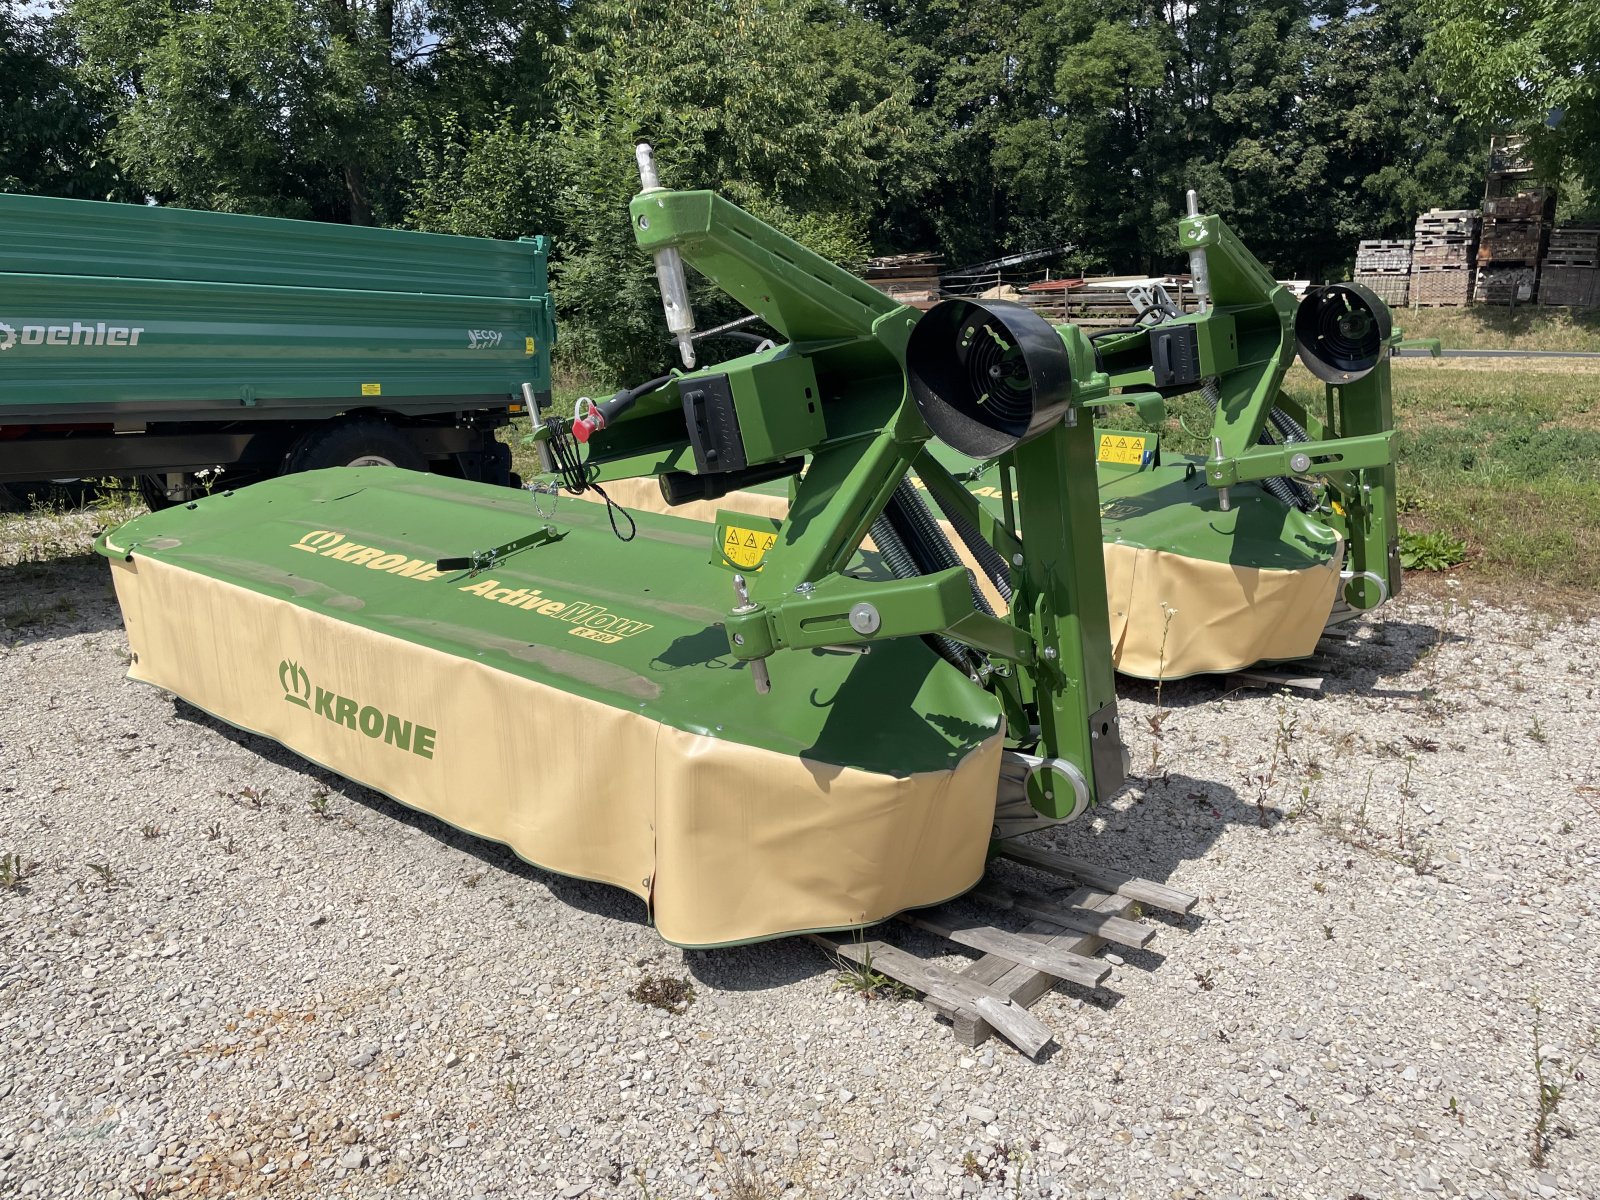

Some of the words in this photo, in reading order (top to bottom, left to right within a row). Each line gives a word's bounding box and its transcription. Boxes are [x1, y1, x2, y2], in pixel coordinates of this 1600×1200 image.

[20, 321, 145, 346] oehler
[473, 329, 498, 340] ECO
[319, 541, 458, 582] KRONE
[457, 579, 655, 638] ActiveMow
[574, 628, 588, 637] R
[586, 631, 615, 642] 280
[314, 685, 437, 760] KRONE
